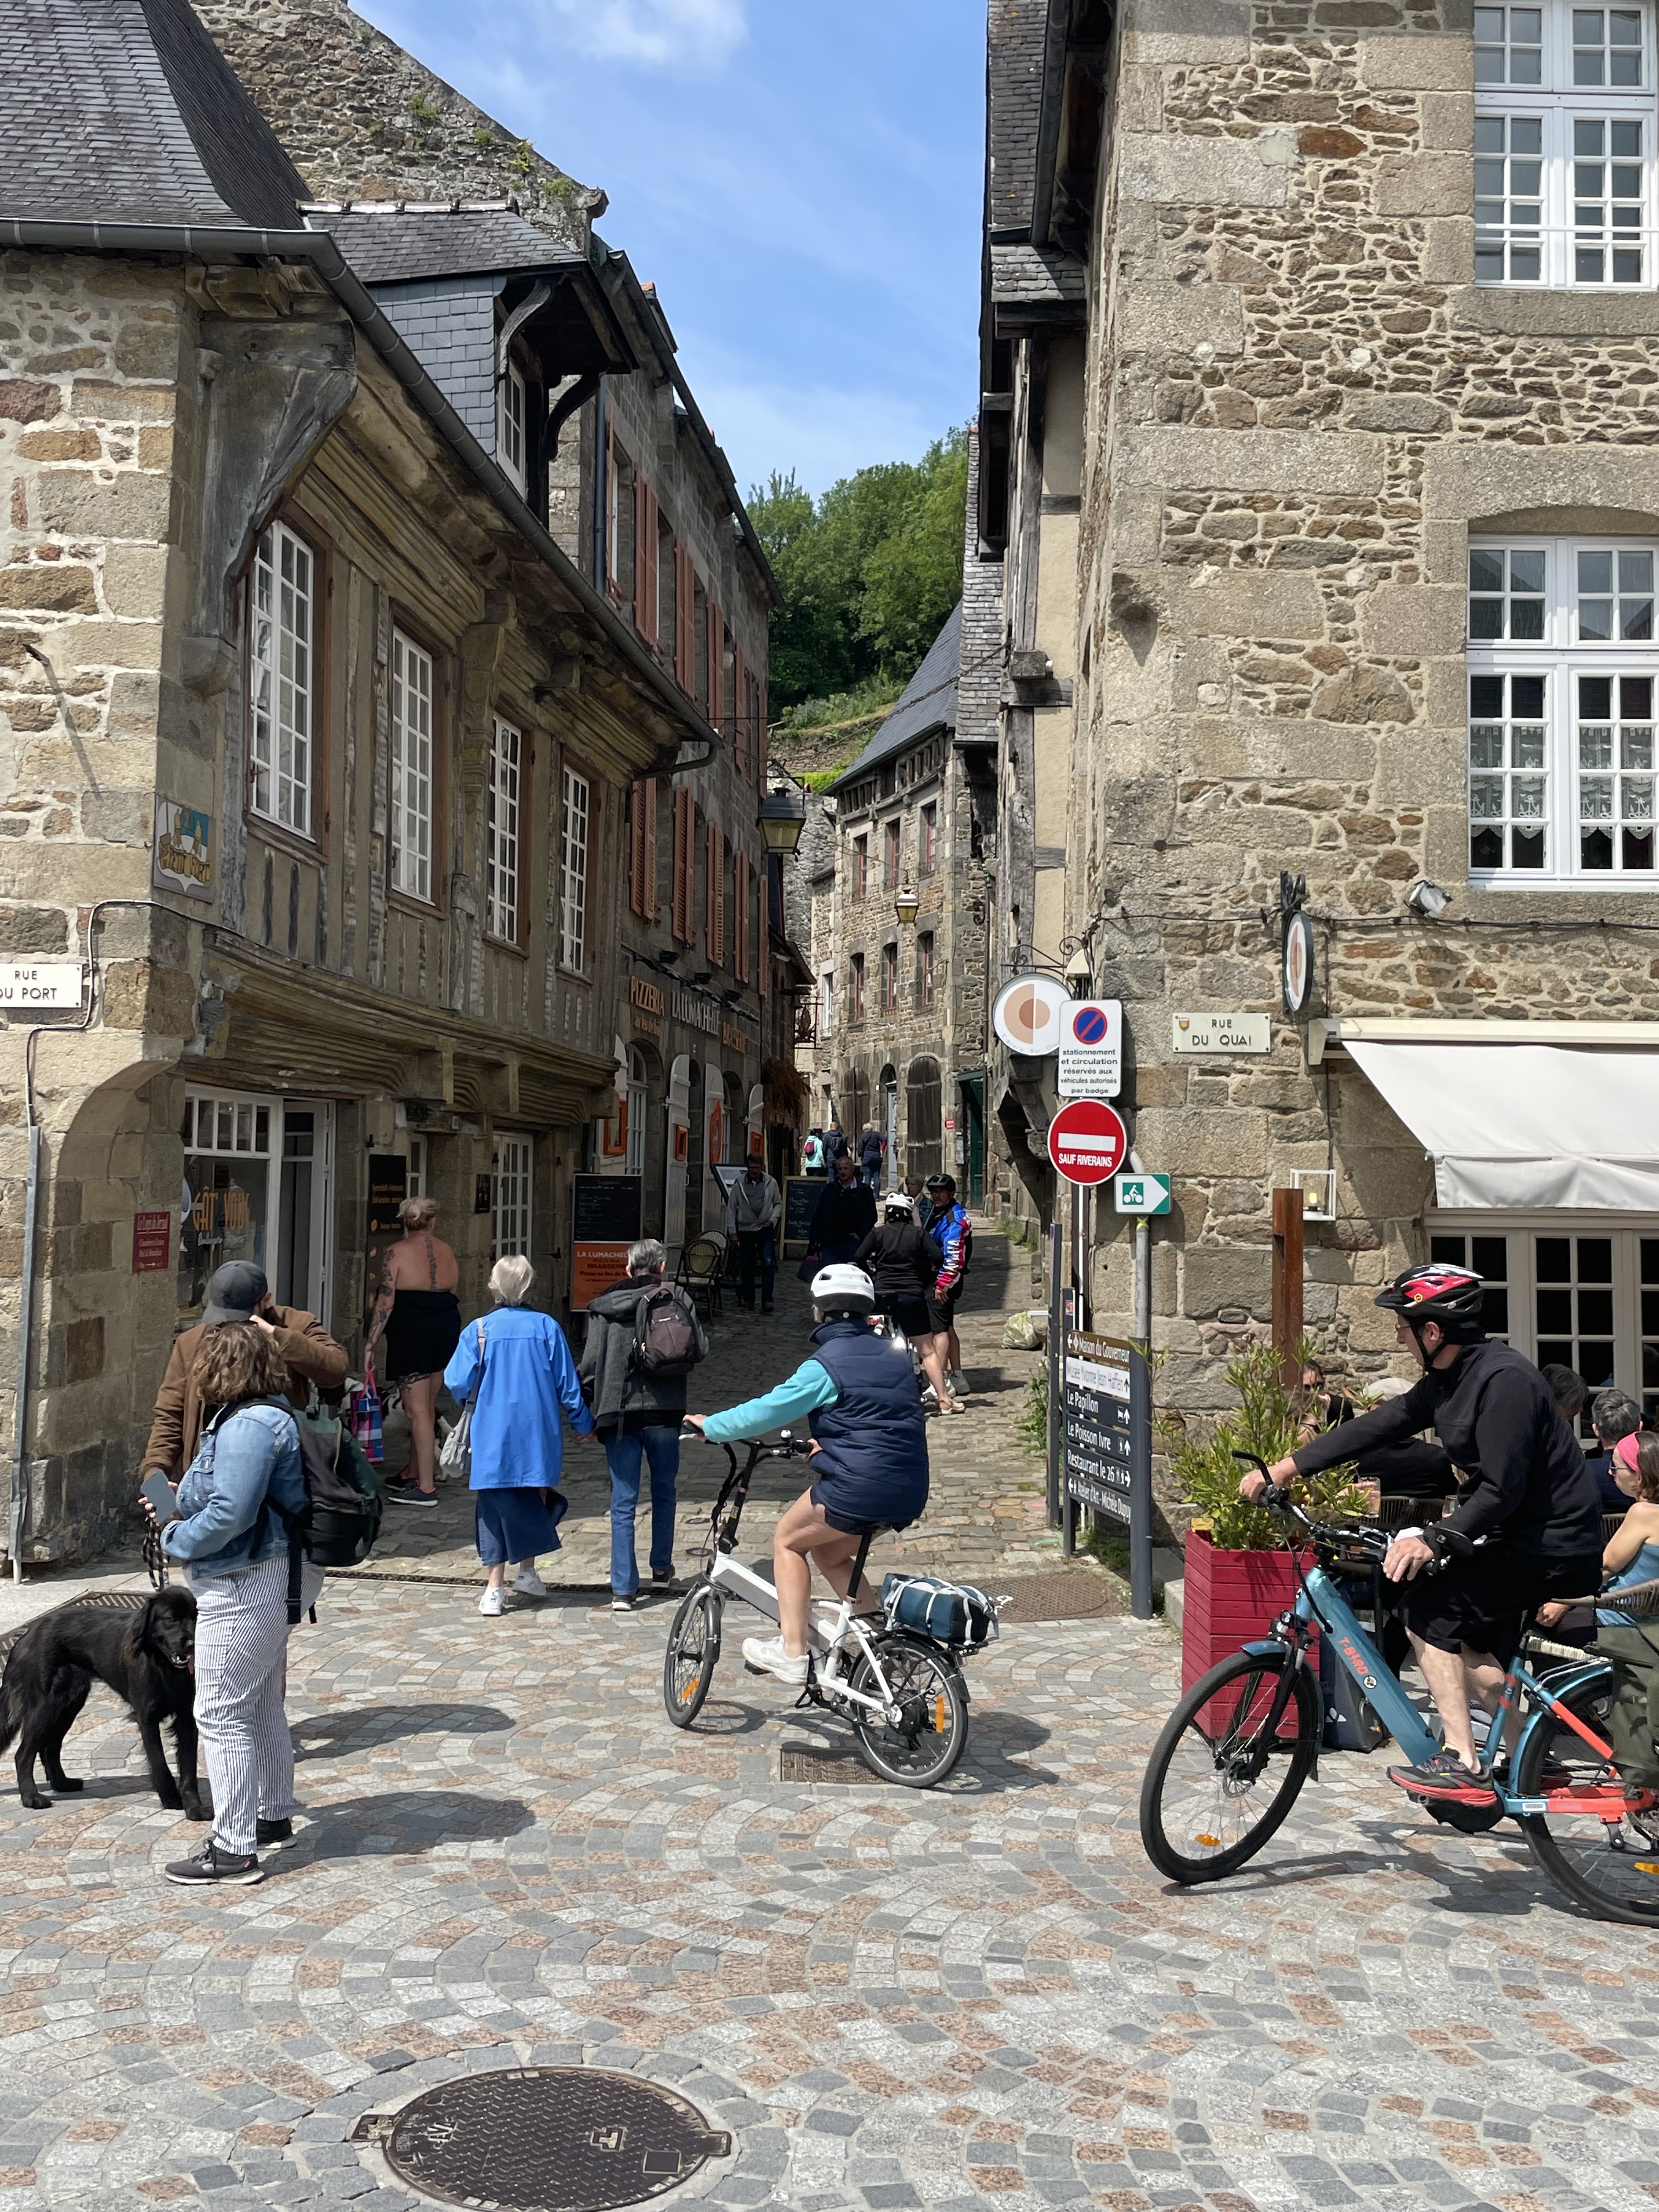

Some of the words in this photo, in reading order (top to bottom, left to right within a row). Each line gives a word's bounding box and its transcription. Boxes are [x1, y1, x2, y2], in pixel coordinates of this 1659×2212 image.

[14, 970, 37, 980] RUE
[21, 988, 57, 1000] PORT
[630, 975, 665, 1017] PIZZERIA
[1211, 1019, 1232, 1028] RUE
[1192, 1035, 1209, 1046] DU
[1220, 1035, 1251, 1047] QUAI
[1058, 1153, 1076, 1165] SAUF
[1077, 1154, 1113, 1167] RIVERAINS
[1079, 1336, 1095, 1355] Maison
[1096, 1339, 1102, 1357] du
[1067, 1389, 1074, 1406] Le
[1075, 1391, 1099, 1414] Papillon
[1067, 1420, 1075, 1437] Le
[1075, 1423, 1097, 1446] Poisson
[1098, 1431, 1111, 1451] Ivre
[1067, 1449, 1099, 1476] Restaurant
[1099, 1459, 1106, 1479] le
[1107, 1465, 1115, 1482] 26
[1338, 1637, 1369, 1675] T-BIRD
